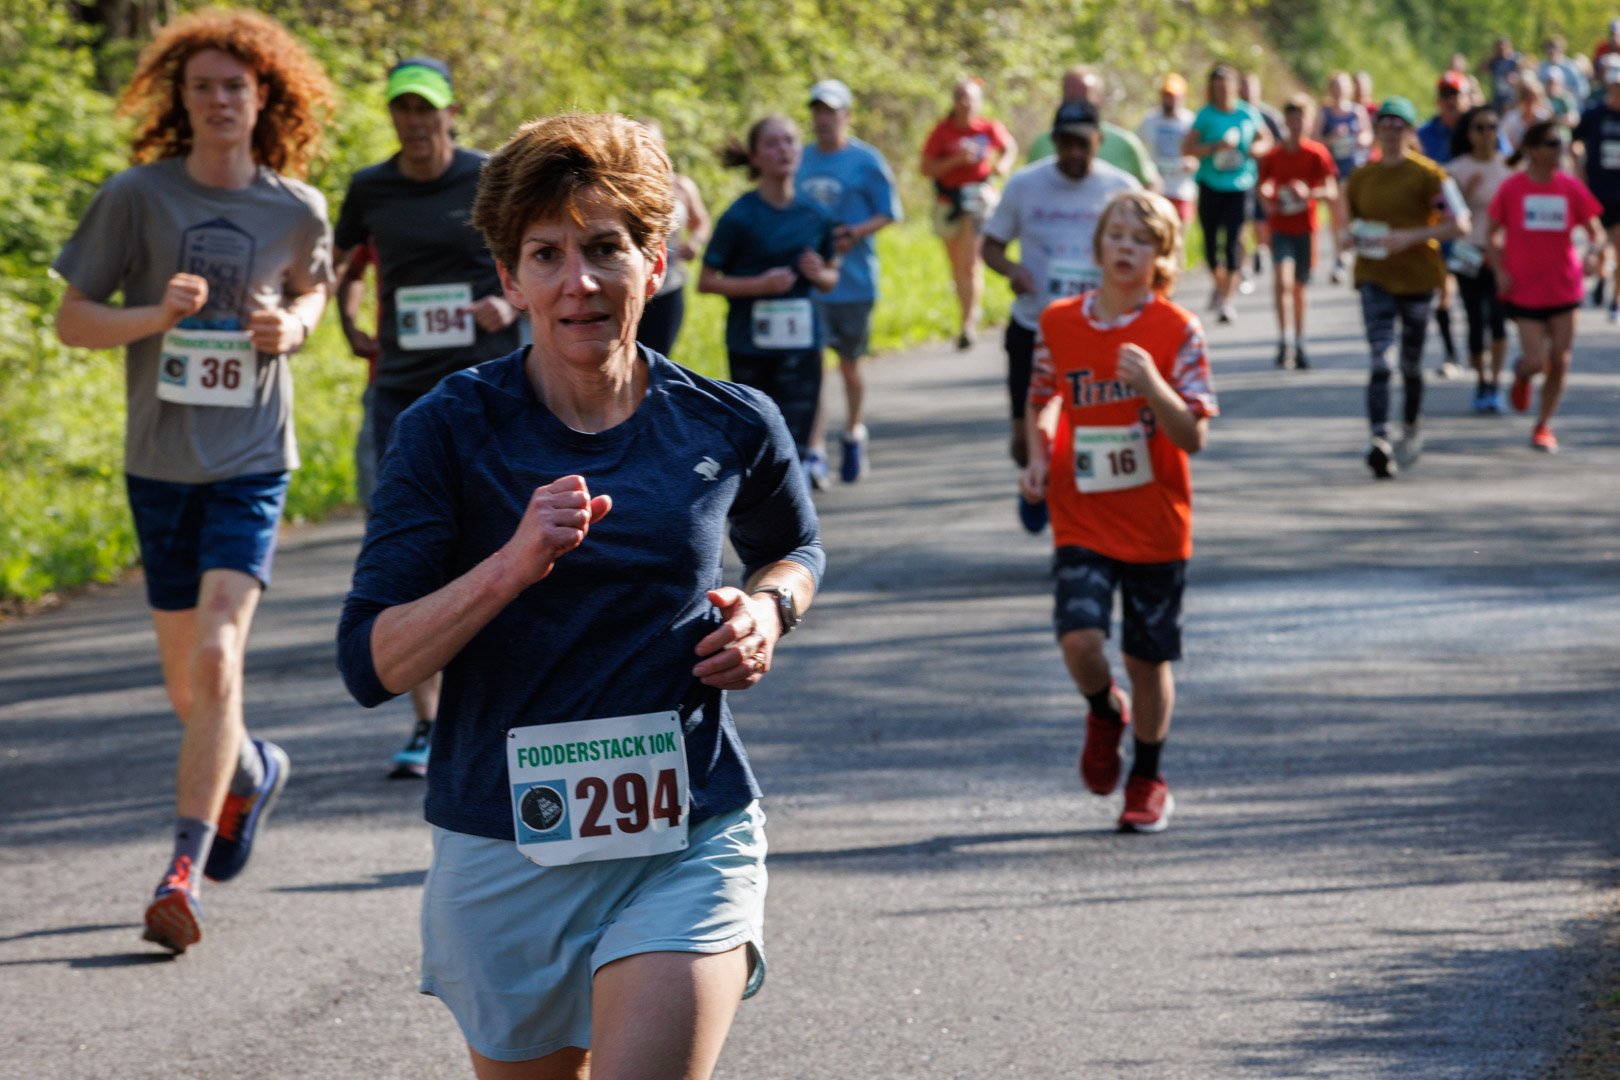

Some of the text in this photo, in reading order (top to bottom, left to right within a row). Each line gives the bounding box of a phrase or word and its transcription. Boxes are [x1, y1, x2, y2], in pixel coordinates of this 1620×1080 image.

[424, 307, 465, 332] 194
[201, 358, 241, 390] 36
[1107, 448, 1137, 476] 16
[517, 732, 676, 768] FODDERSTACK 10K
[575, 768, 683, 838] 294
